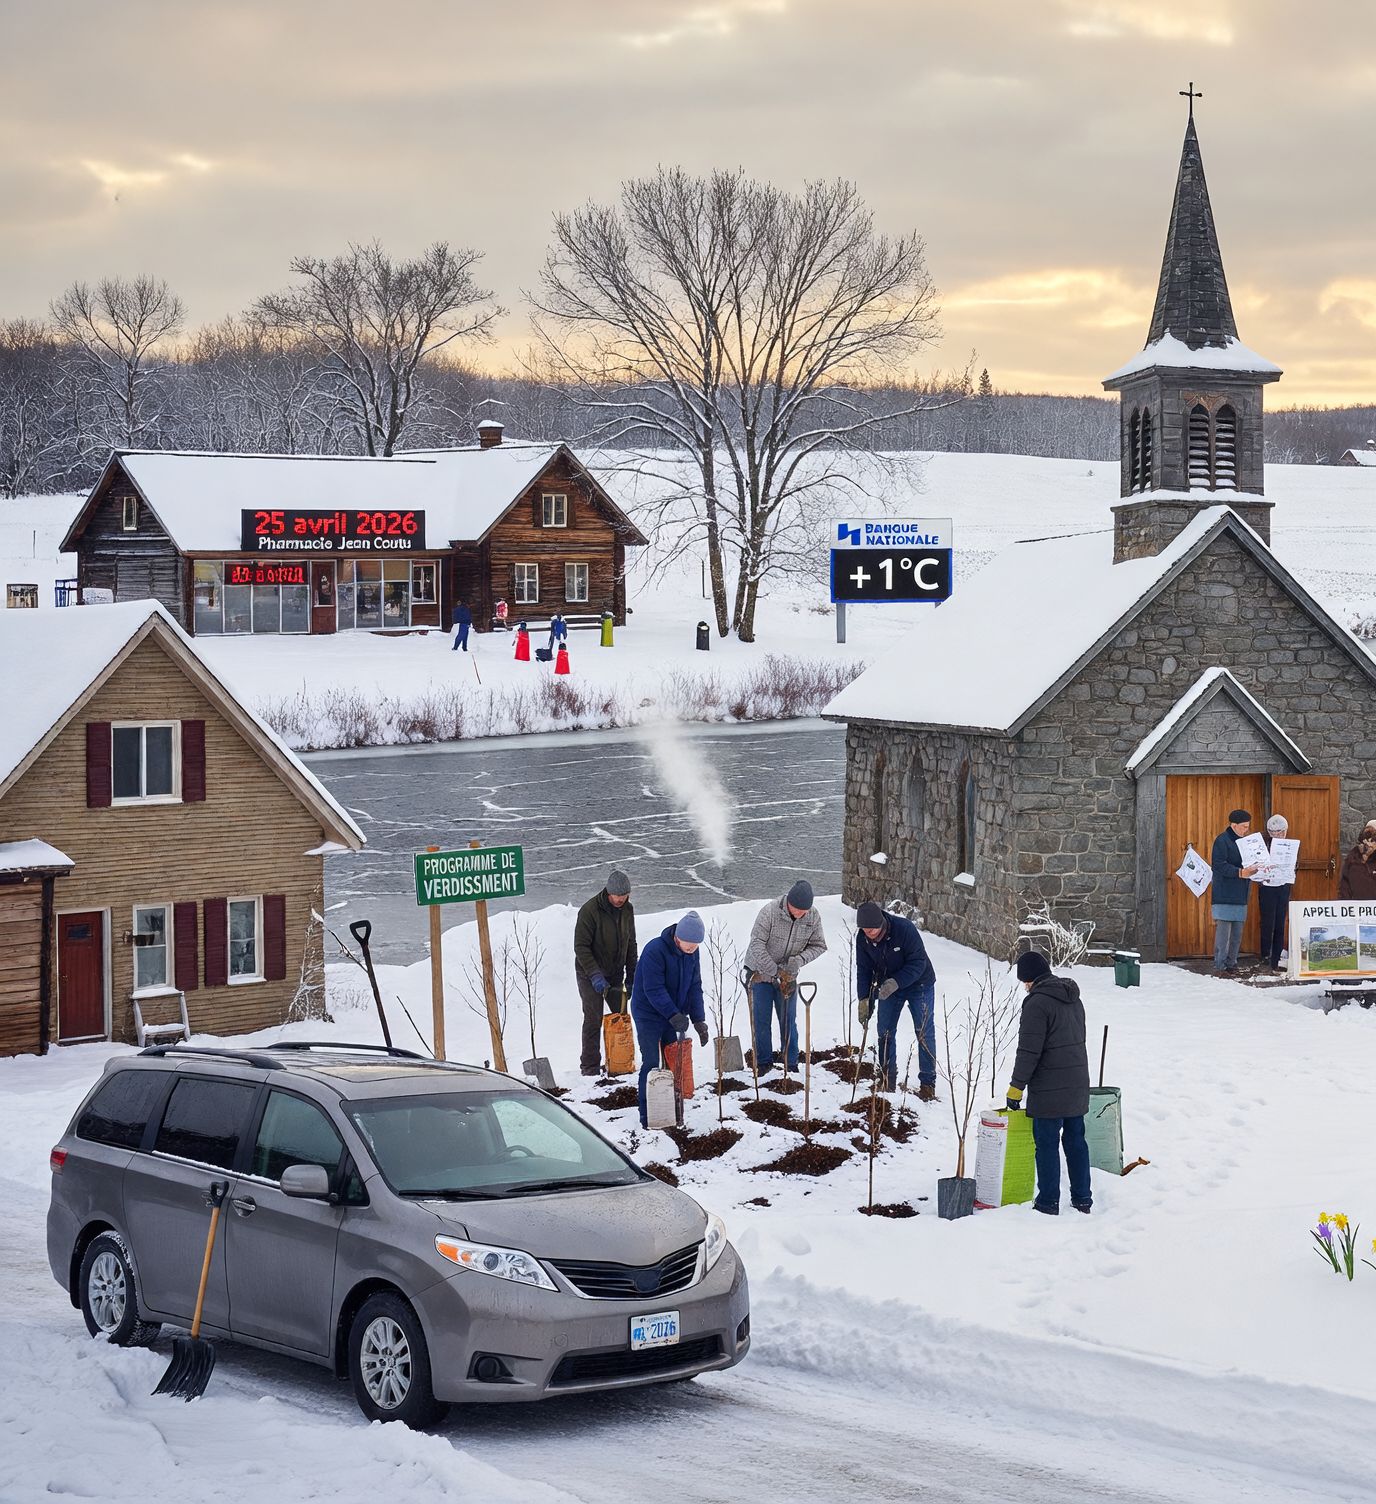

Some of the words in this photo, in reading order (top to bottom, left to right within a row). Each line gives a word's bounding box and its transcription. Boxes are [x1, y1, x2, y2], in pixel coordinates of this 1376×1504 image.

[254, 511, 285, 535] 25
[293, 511, 348, 536] avril
[356, 511, 418, 536] 2026
[865, 523, 918, 534] BANQUE
[337, 536, 371, 550] Jean
[866, 534, 939, 546] NATIONALE
[849, 557, 940, 591] +1°C
[424, 853, 498, 876] PROGRAMME
[501, 852, 517, 869] DE
[423, 872, 519, 900] VERDISSMENT
[1303, 906, 1338, 918] APPEL
[1341, 906, 1356, 917] DE
